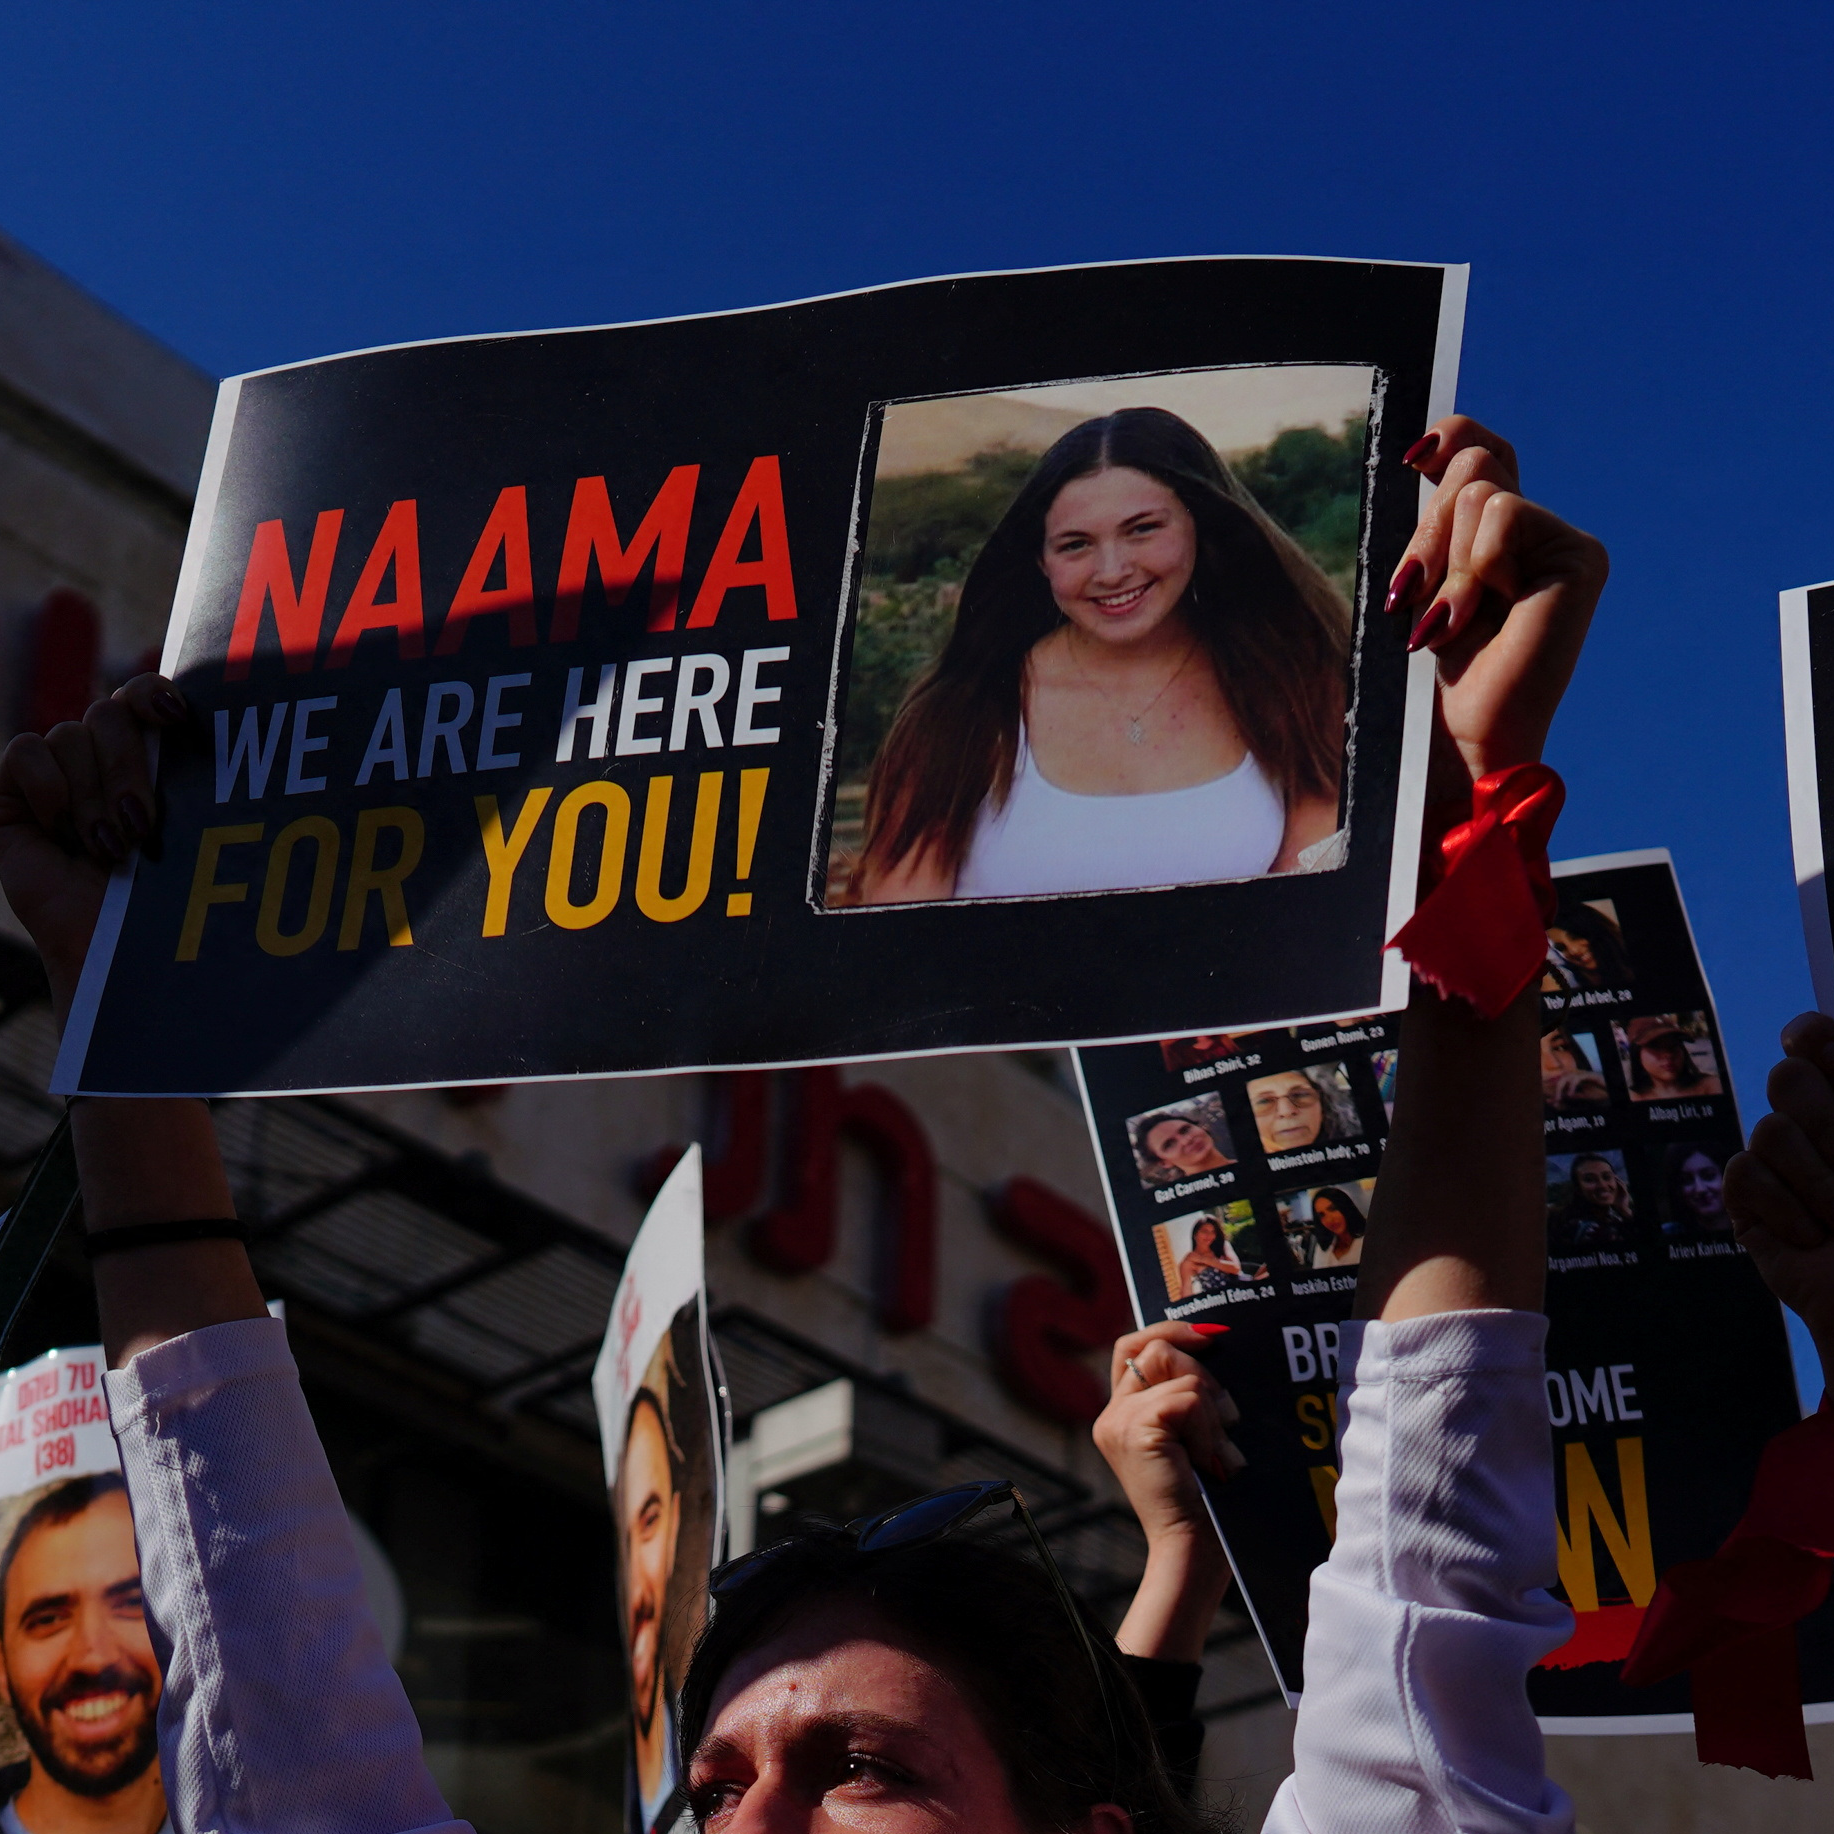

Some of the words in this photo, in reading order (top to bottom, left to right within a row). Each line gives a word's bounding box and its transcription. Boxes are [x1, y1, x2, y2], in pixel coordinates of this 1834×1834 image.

[222, 455, 799, 682] NAAMA
[213, 695, 339, 804] WE
[354, 673, 532, 787] ARE
[555, 646, 791, 764] HERE
[174, 805, 427, 962] FOR
[473, 767, 771, 938] YOU!
[35, 1431, 76, 1477] (38)
[1545, 1363, 1643, 1428] OME
